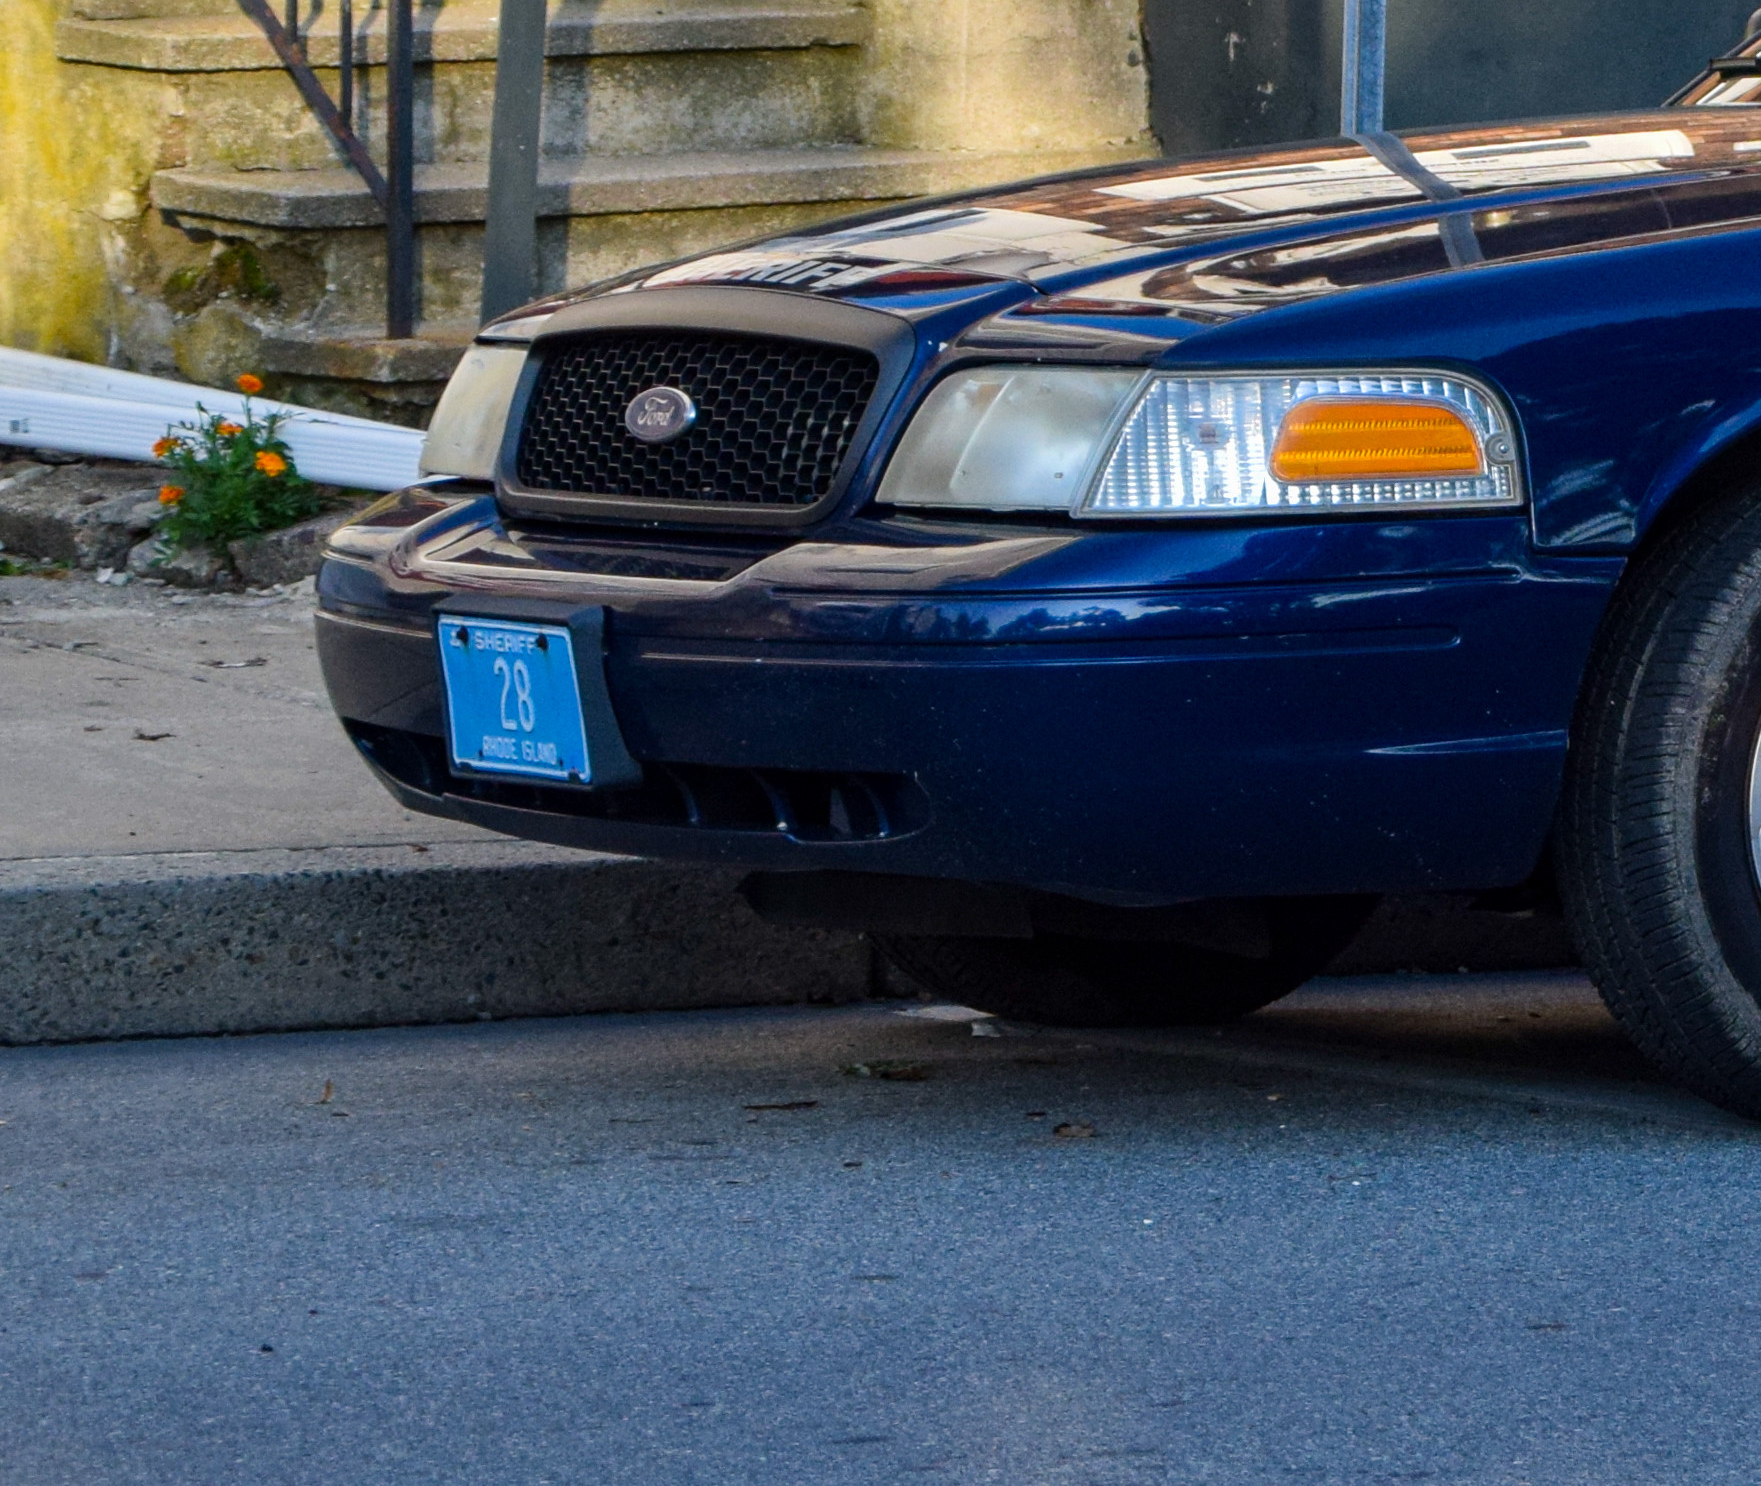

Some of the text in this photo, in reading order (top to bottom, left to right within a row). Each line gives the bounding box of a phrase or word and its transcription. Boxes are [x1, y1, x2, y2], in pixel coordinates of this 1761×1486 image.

[637, 396, 675, 426] Ford
[475, 632, 538, 654] SHERIFF
[493, 656, 535, 733] 28
[482, 735, 557, 765] RHODE ISLAND
